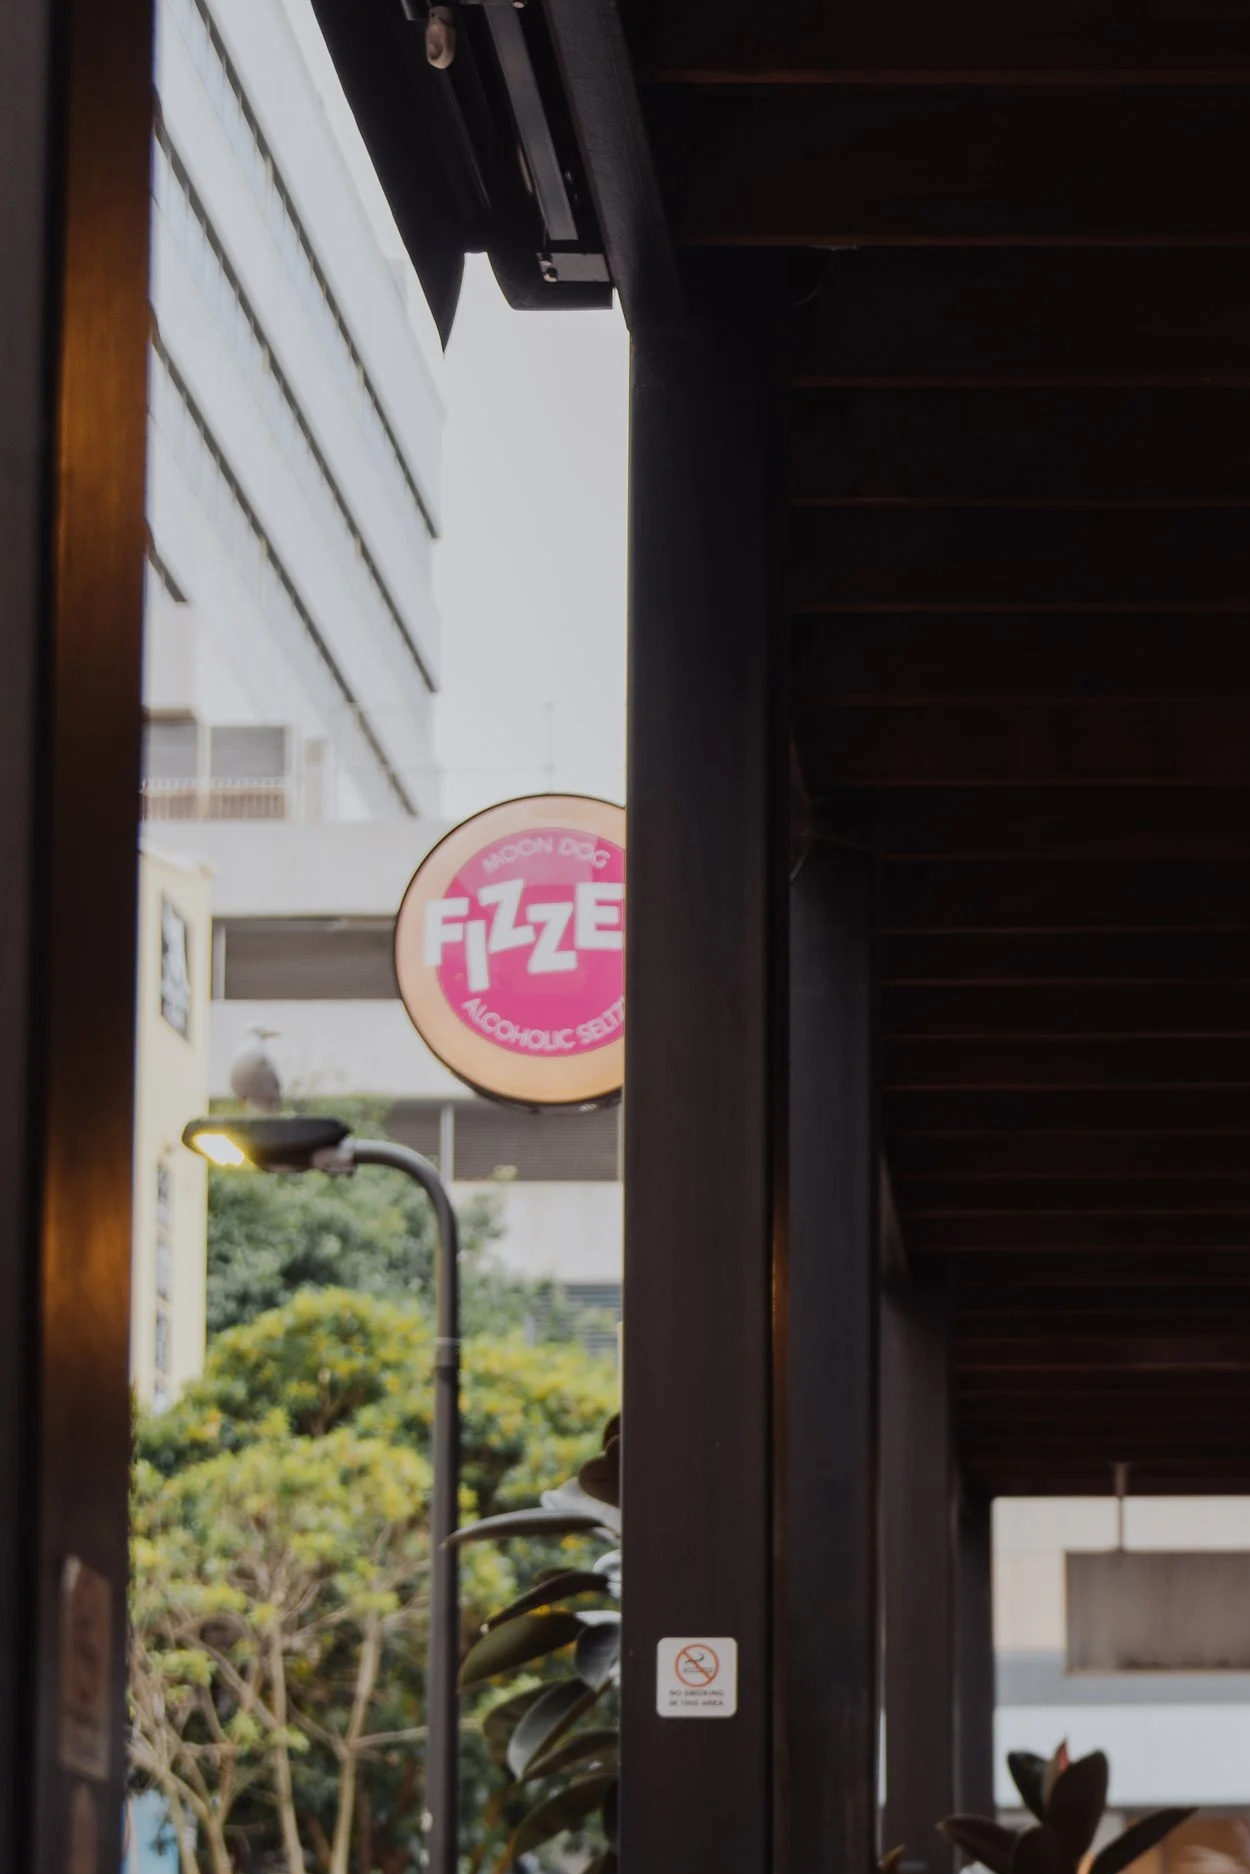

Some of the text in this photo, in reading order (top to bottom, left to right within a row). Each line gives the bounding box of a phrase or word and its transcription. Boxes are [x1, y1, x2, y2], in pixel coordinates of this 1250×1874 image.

[483, 837, 610, 873] MOON DOG
[462, 998, 576, 1049] ALCOHOLIC
[669, 1689, 724, 1697] NO SMOKING
